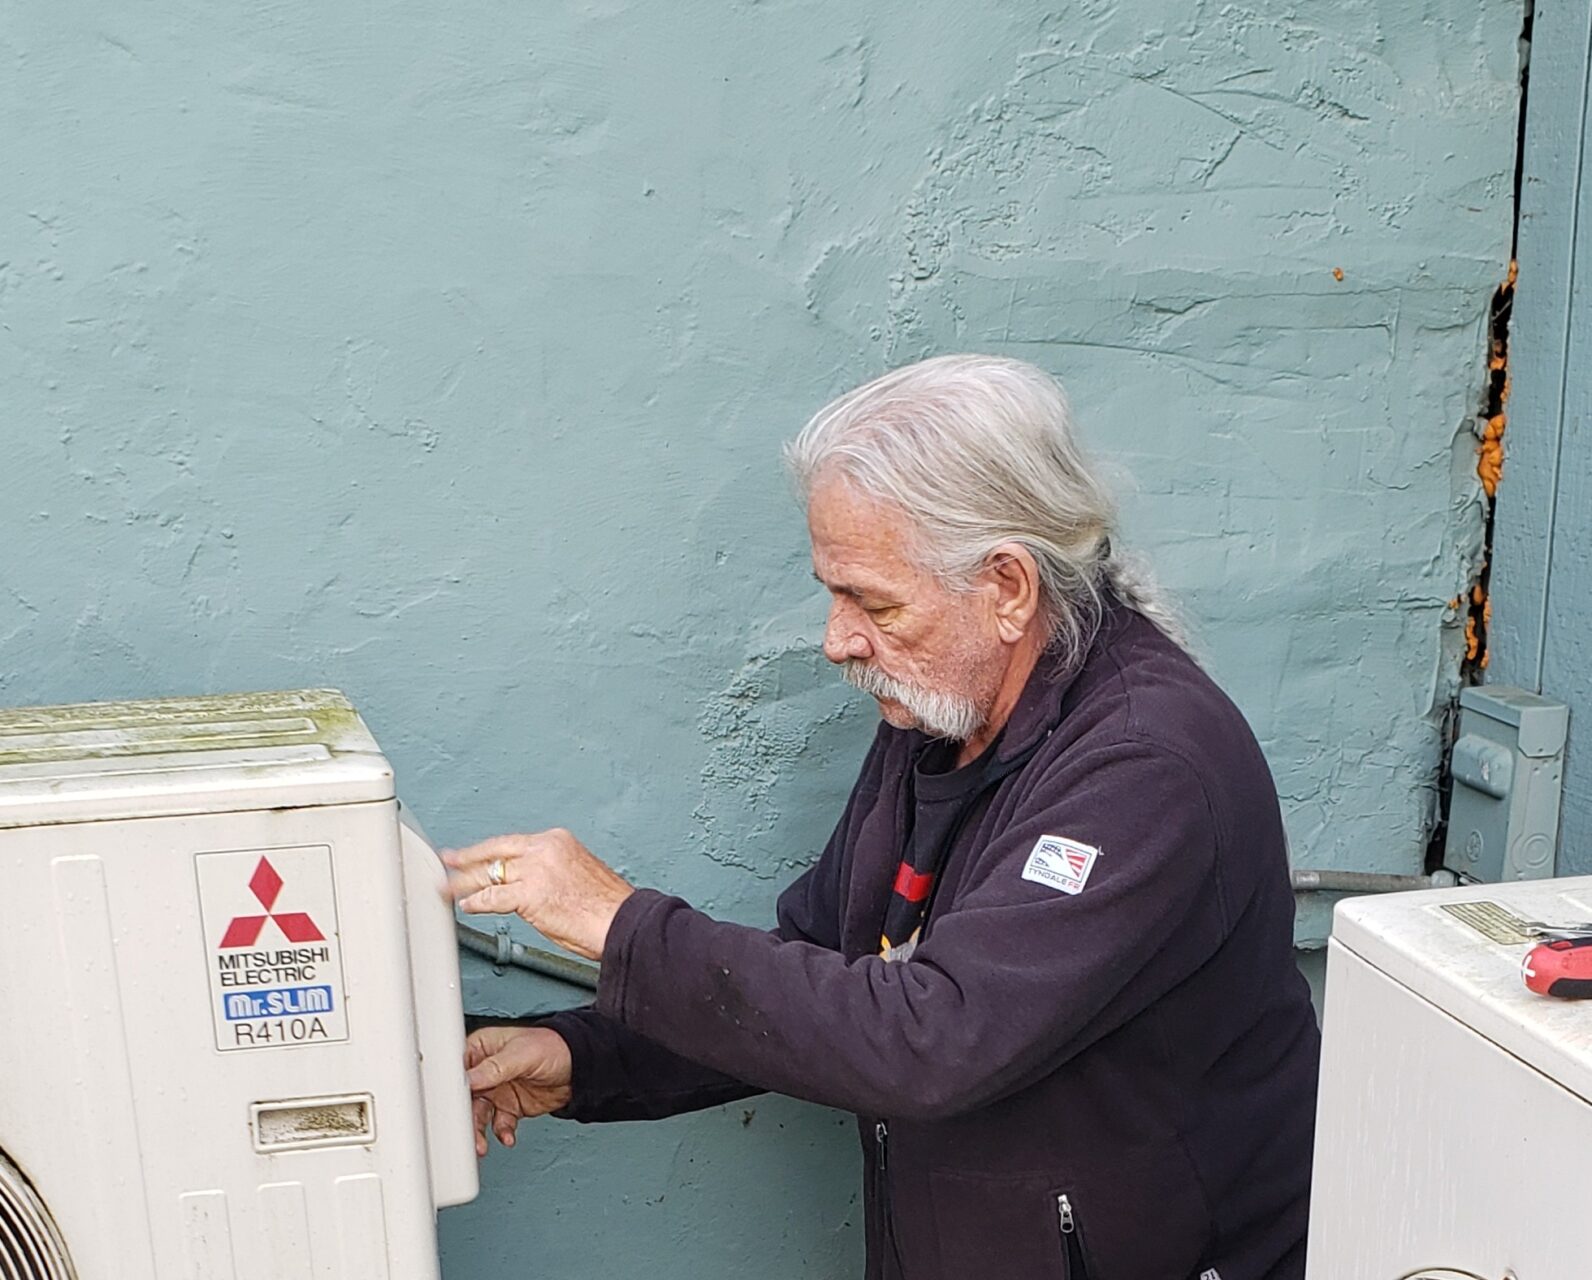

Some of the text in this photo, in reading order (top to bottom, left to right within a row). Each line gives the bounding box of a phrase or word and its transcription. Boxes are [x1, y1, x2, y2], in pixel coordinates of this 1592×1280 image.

[1028, 868, 1067, 886] TYNDALE
[218, 947, 329, 970] MITSUBISHI
[221, 967, 316, 986] ELECTRIC
[234, 1018, 328, 1045] R410A
